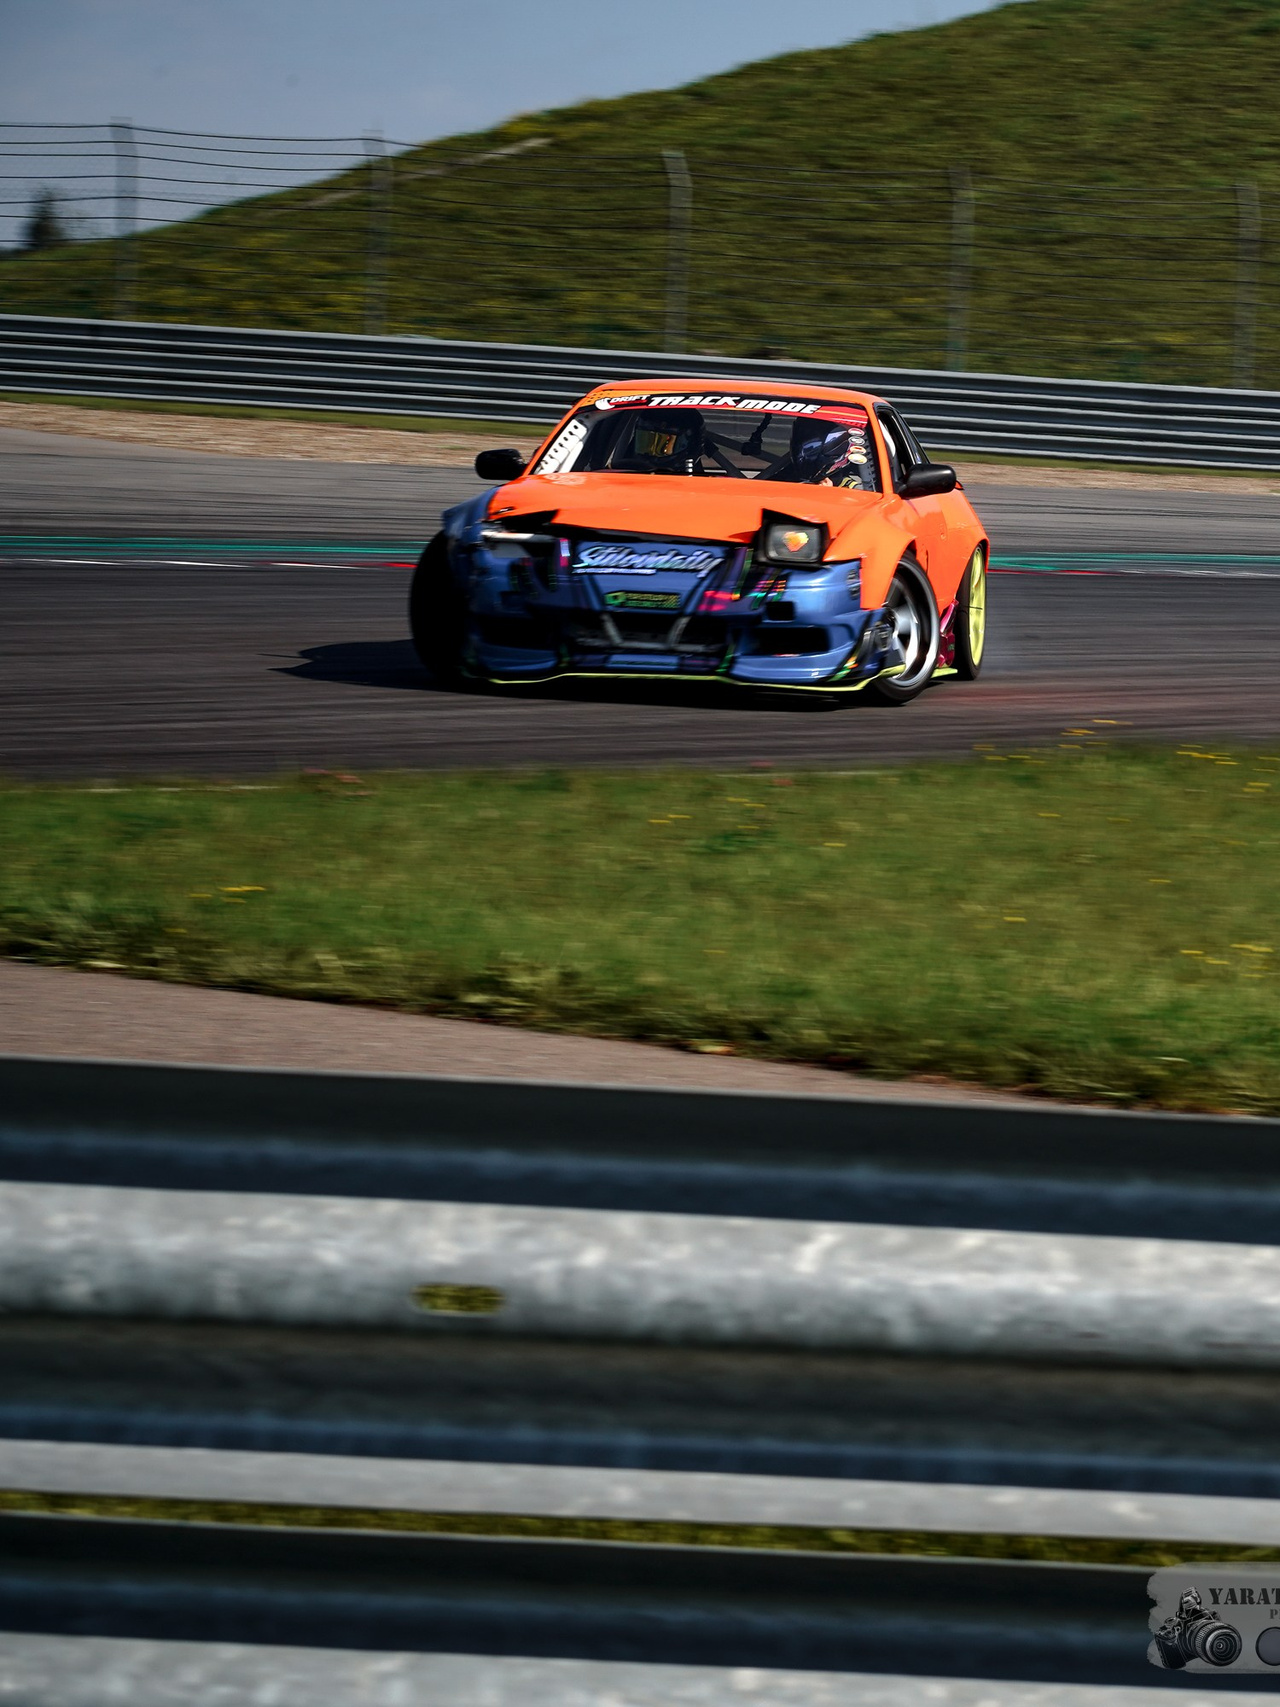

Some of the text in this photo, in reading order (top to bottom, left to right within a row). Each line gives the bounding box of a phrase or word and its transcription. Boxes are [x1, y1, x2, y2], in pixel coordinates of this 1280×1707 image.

[610, 394, 651, 404] DRIFT
[647, 396, 741, 408] TRACK
[735, 399, 822, 414] MODE
